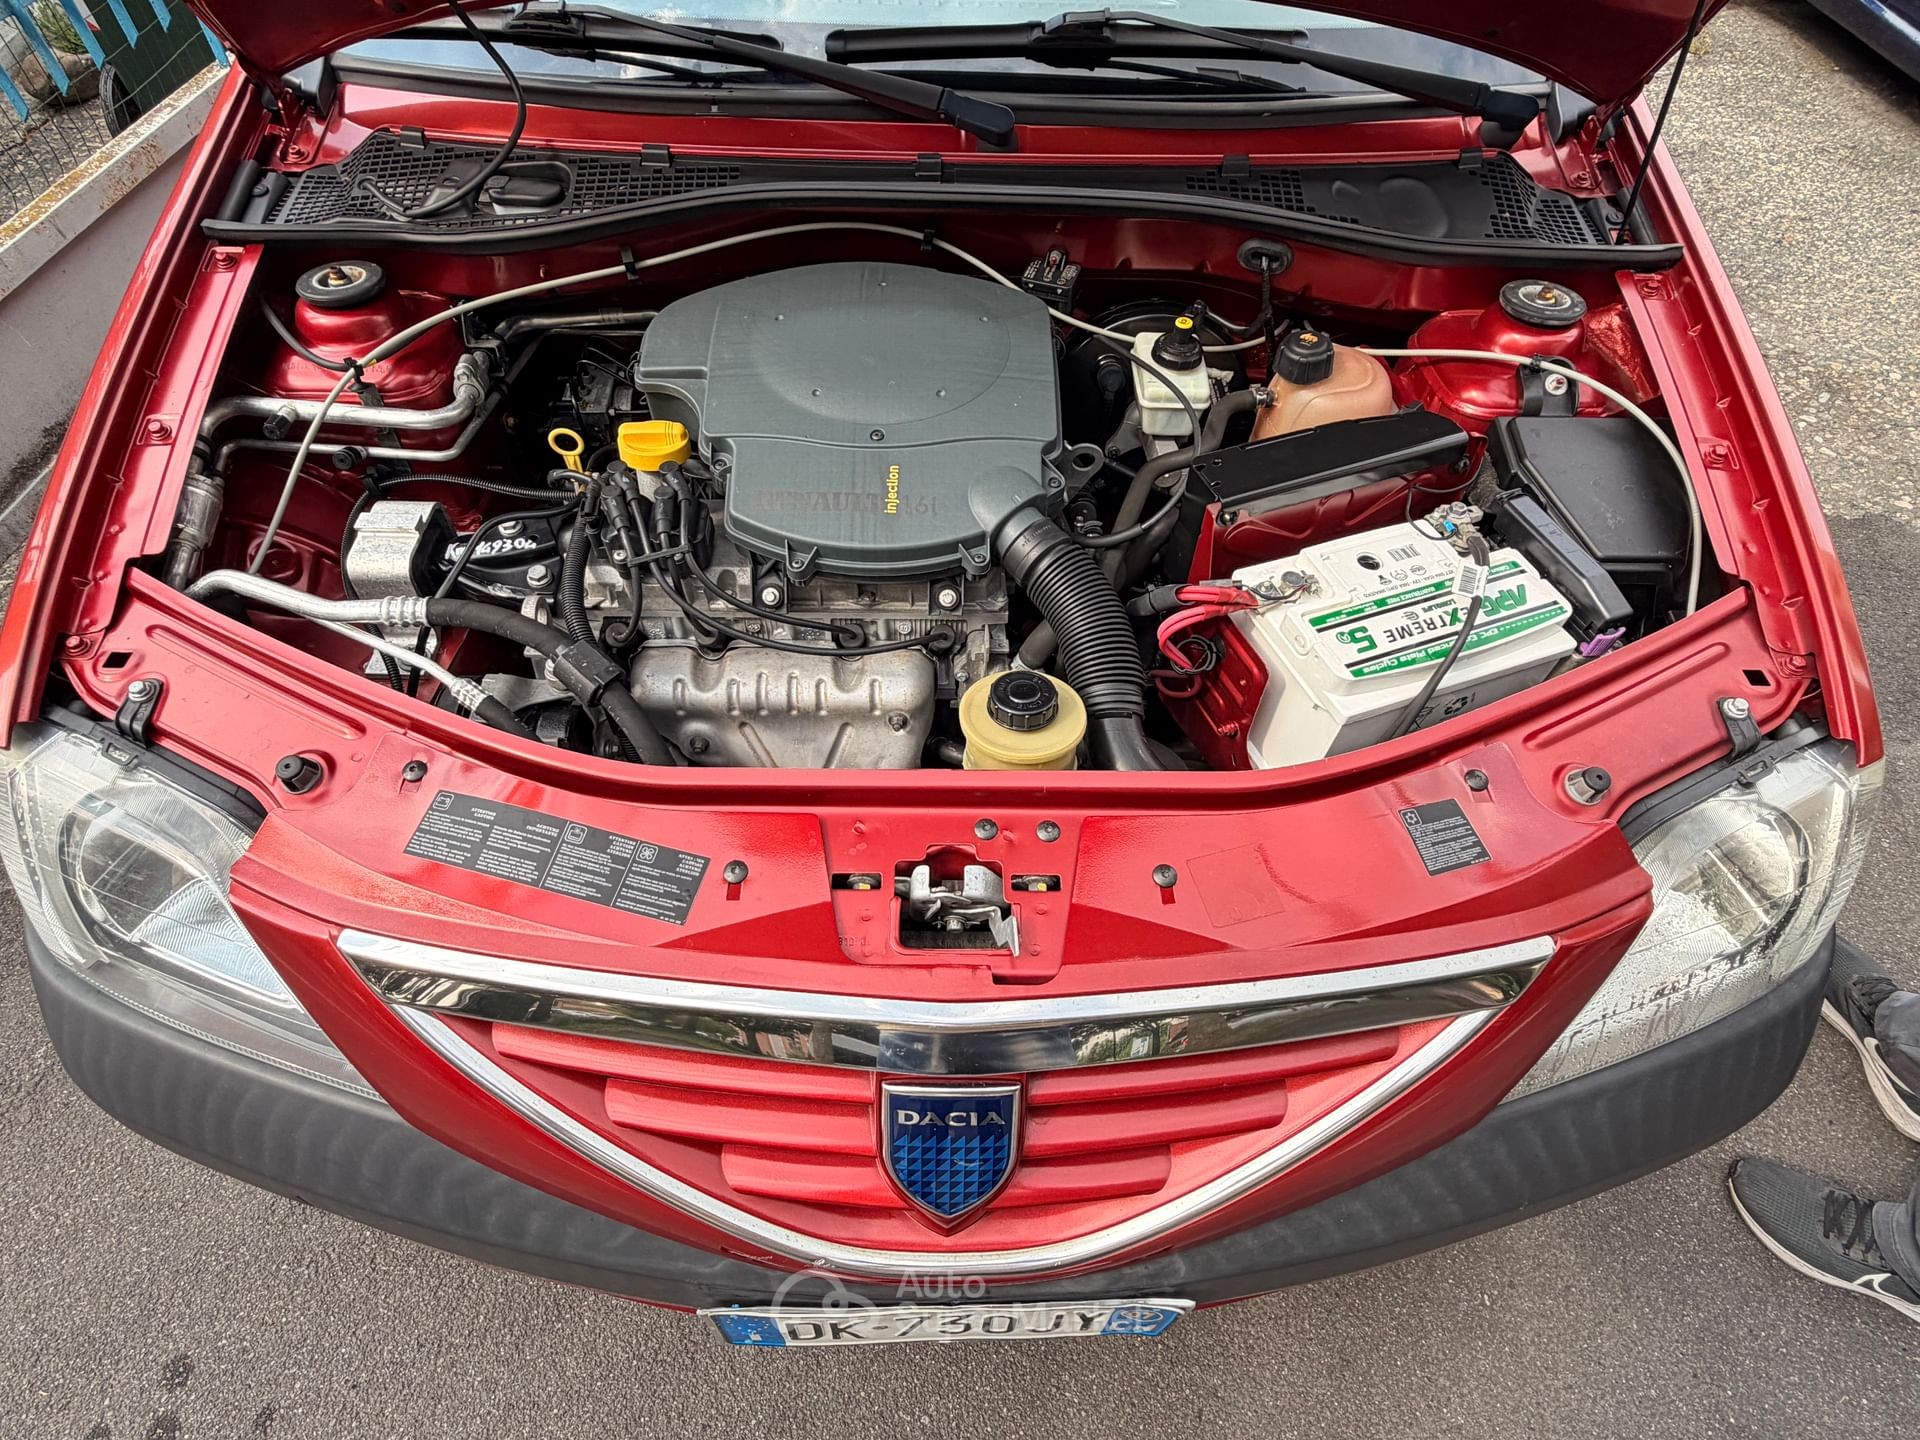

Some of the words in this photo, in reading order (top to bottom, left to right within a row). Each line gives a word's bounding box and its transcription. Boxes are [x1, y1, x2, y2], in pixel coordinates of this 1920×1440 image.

[883, 464, 900, 515] injection
[1400, 648, 1426, 662] Plate
[1362, 658, 1399, 674] Cycles
[896, 1109, 1006, 1127] DACIA
